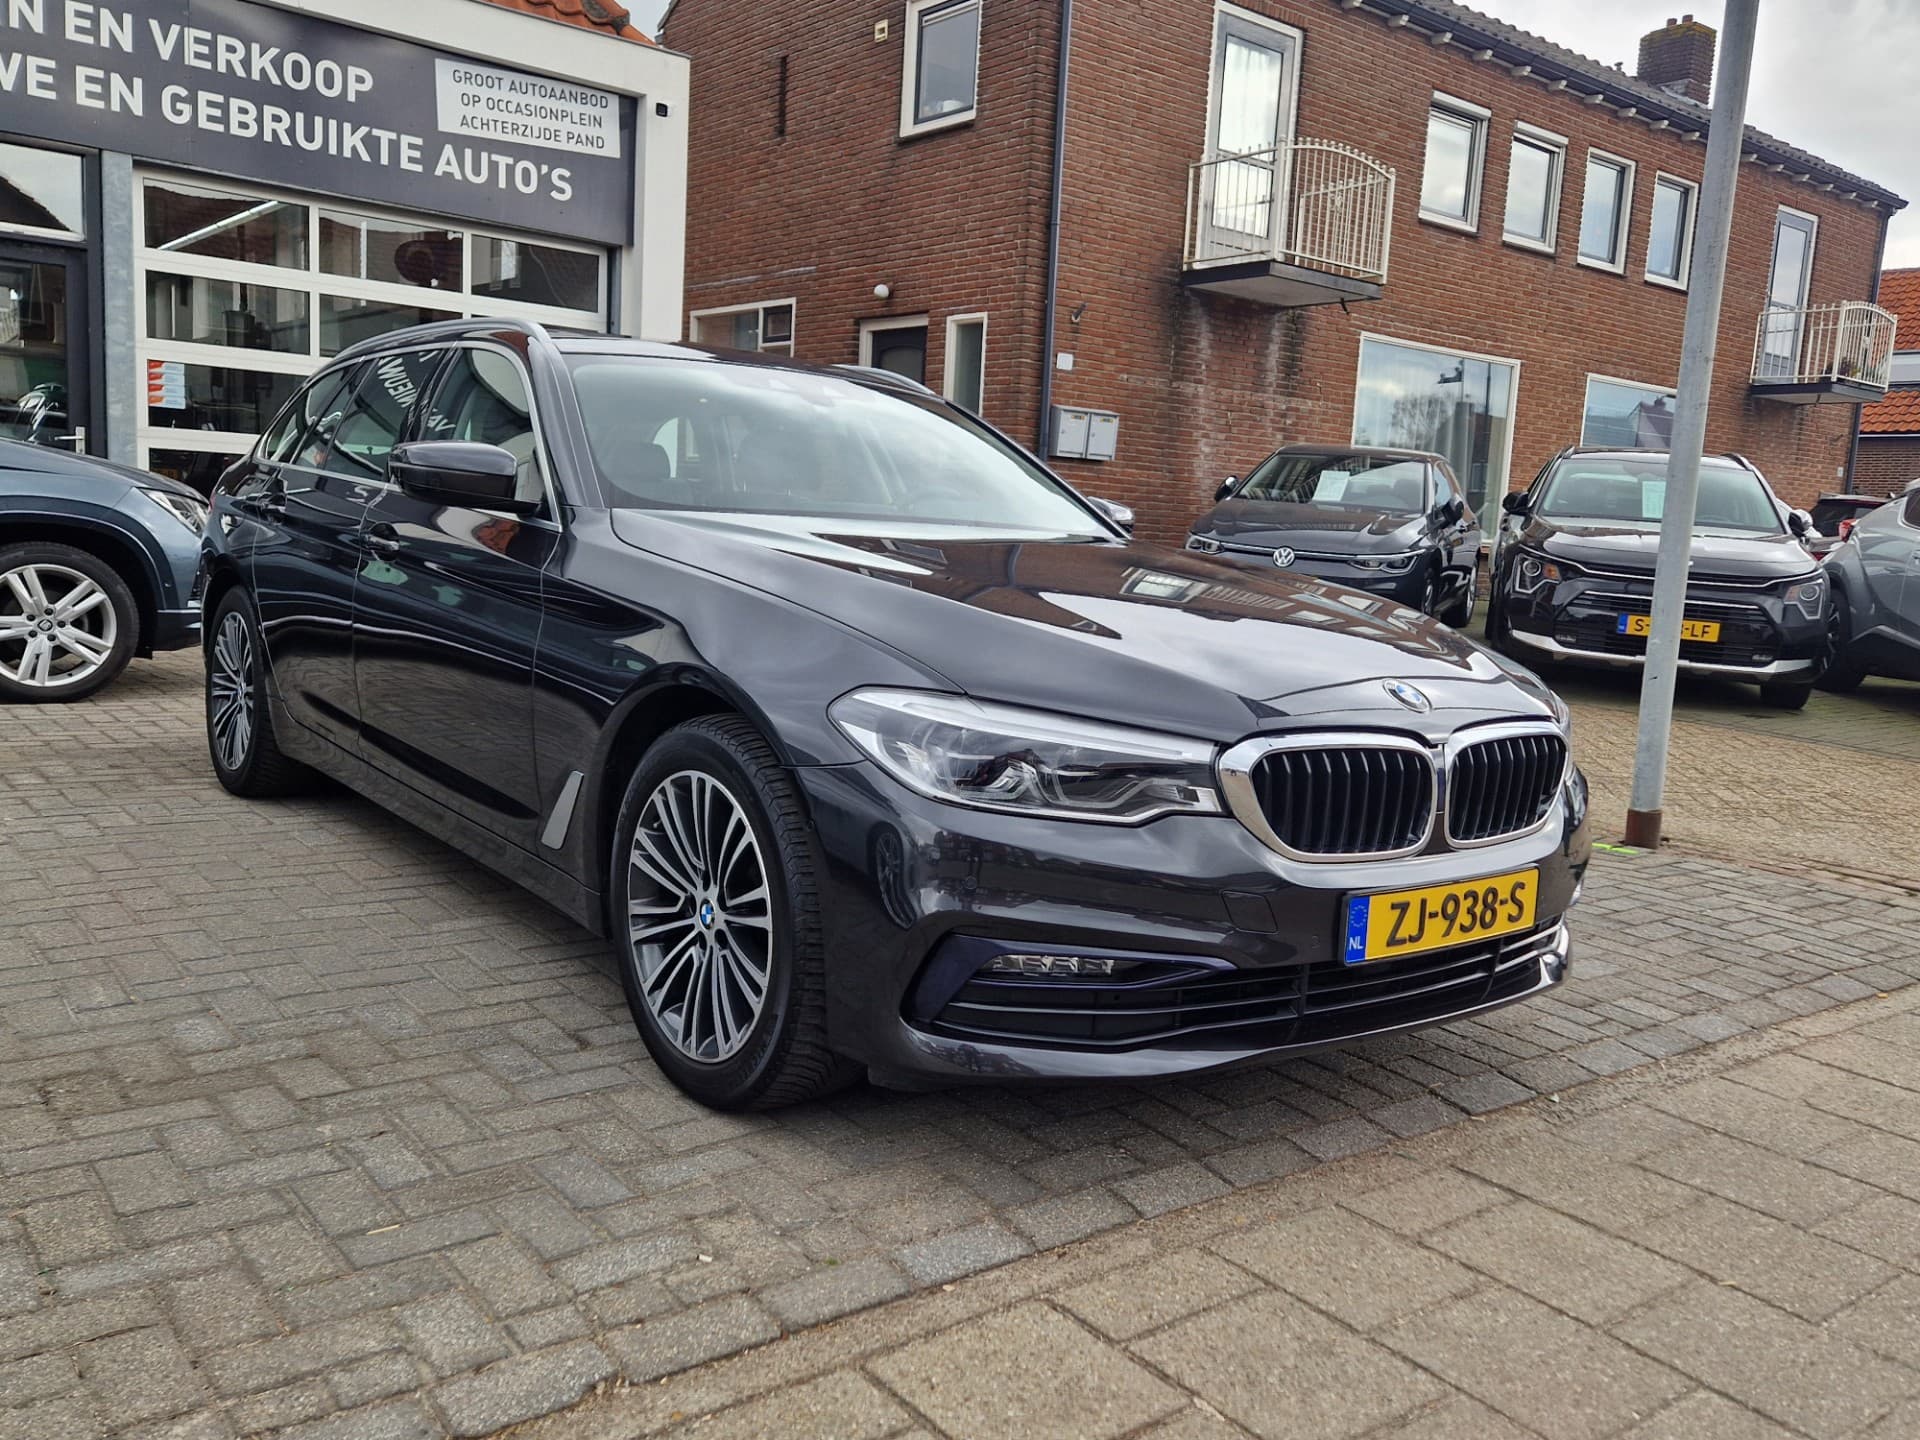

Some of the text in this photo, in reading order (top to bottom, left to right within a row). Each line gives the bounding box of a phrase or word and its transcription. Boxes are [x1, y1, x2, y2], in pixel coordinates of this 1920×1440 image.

[64, 0, 133, 53] EN
[148, 18, 373, 103] VERKOOP
[452, 69, 608, 109] GROOT AUTOAANBOD
[461, 92, 602, 128] OP OCCASIONPLEIN
[75, 64, 144, 117] EN
[161, 84, 423, 173] GEBRUIKTE
[434, 143, 572, 201] AUTO'S
[460, 114, 605, 149] ACHTERZIJDE PAND
[1634, 618, 1711, 638] S--LF
[1349, 881, 1526, 950] NL ZJ-938-S
